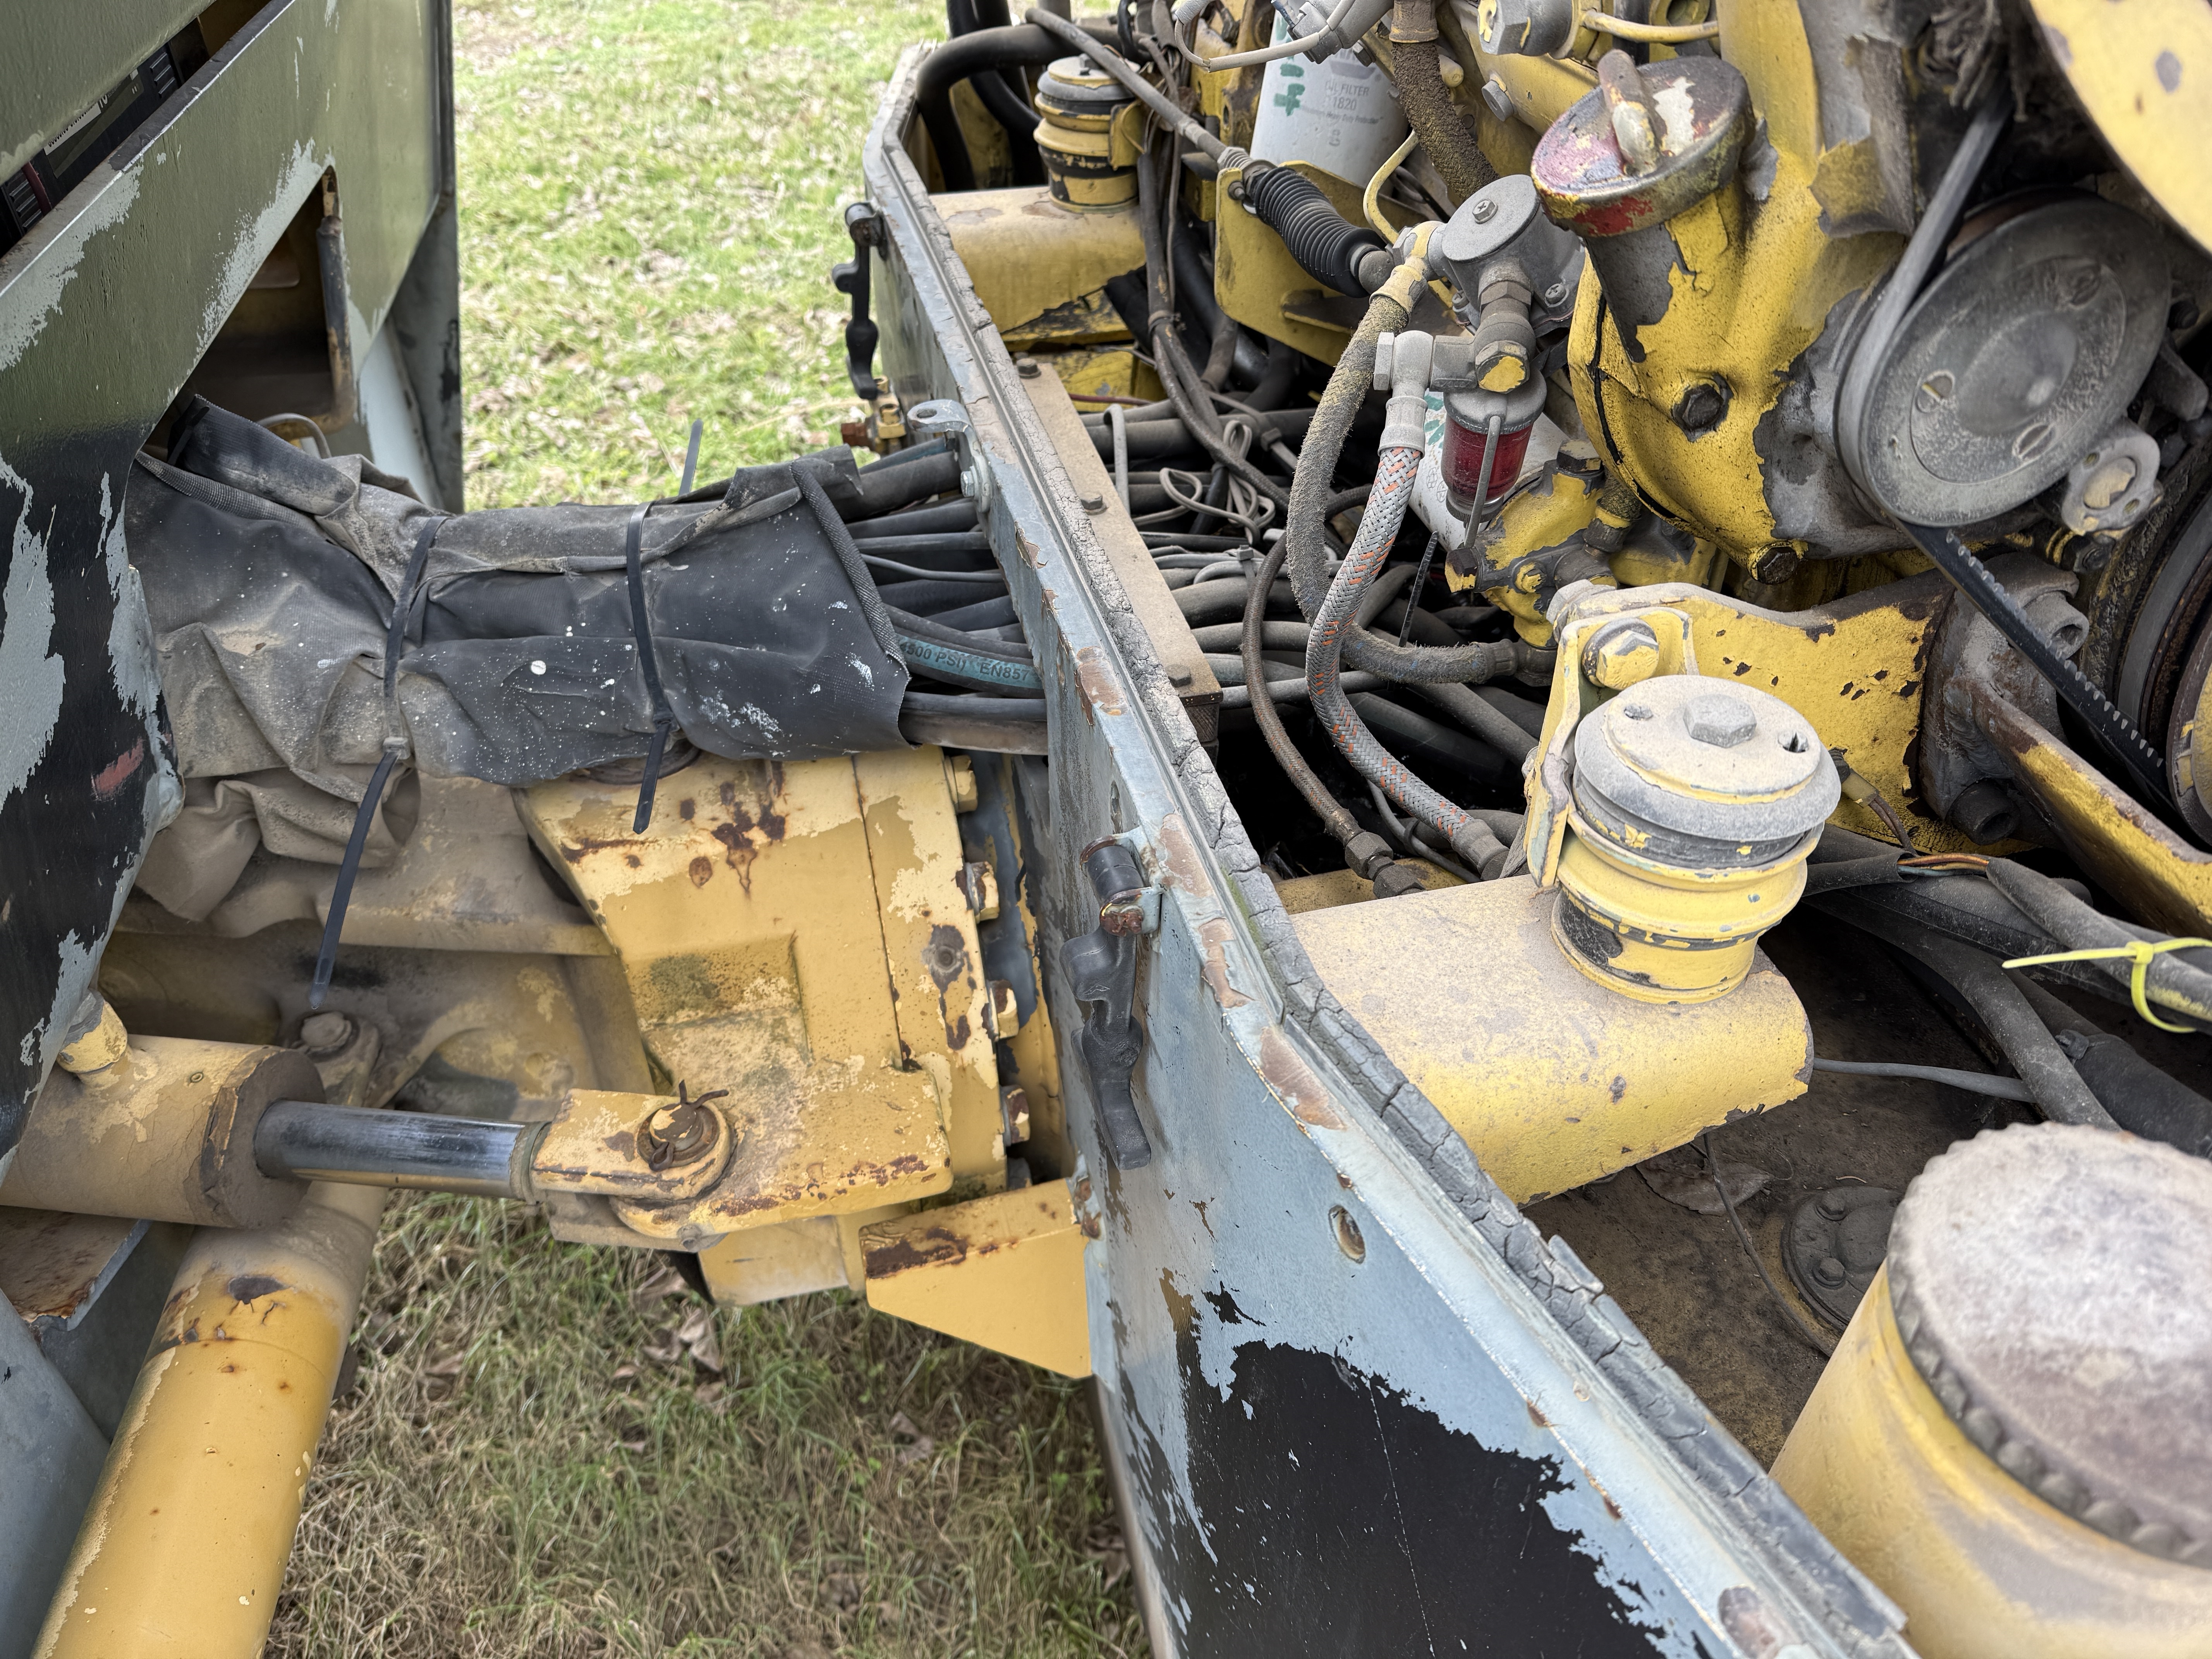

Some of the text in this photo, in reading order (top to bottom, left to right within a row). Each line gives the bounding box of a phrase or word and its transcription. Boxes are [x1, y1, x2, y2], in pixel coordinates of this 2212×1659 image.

[1340, 83, 1370, 96] FILTER
[1333, 96, 1357, 111] 1820
[900, 642, 1030, 681] 4500 PSI) EN857
